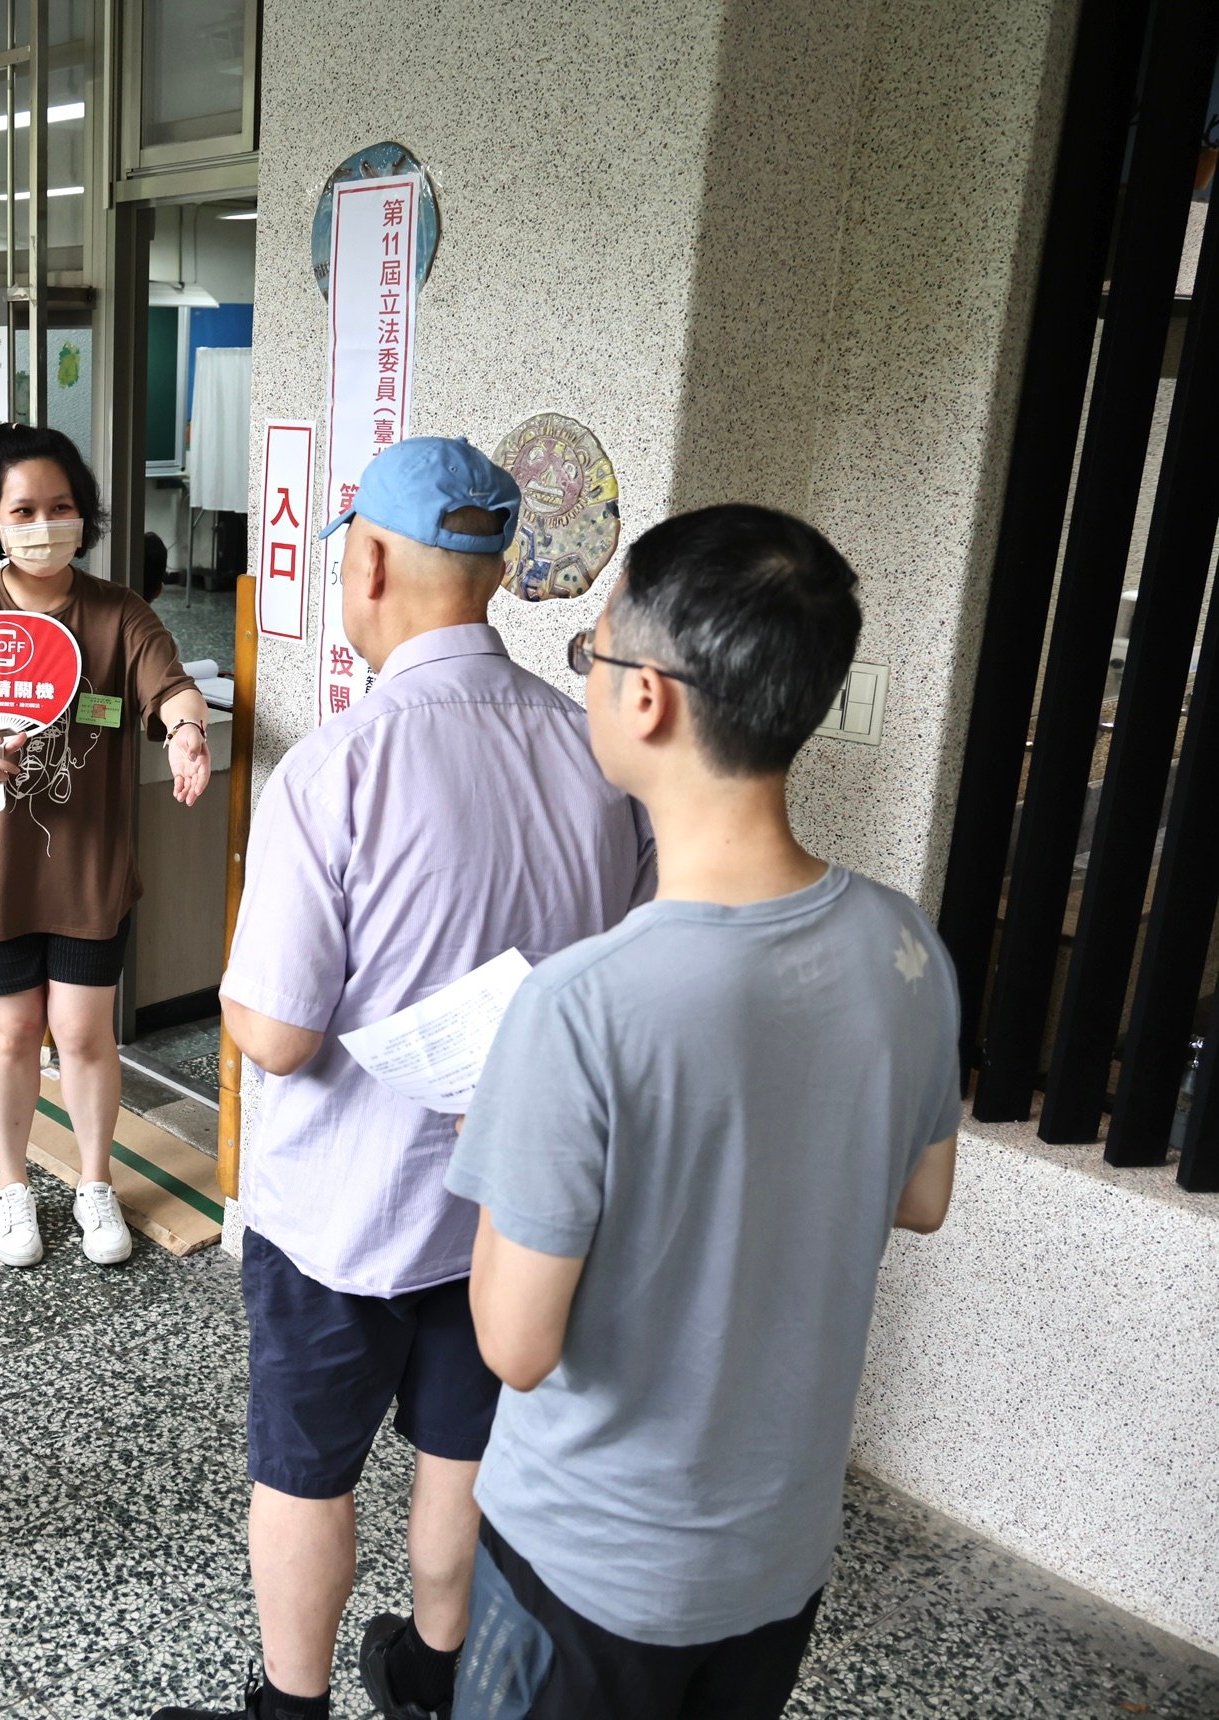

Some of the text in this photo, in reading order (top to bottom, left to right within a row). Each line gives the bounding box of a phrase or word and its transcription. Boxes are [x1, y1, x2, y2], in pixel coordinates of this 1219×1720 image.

[371, 198, 405, 456] 第11屆立法委員(臺
[270, 487, 299, 581] 入口
